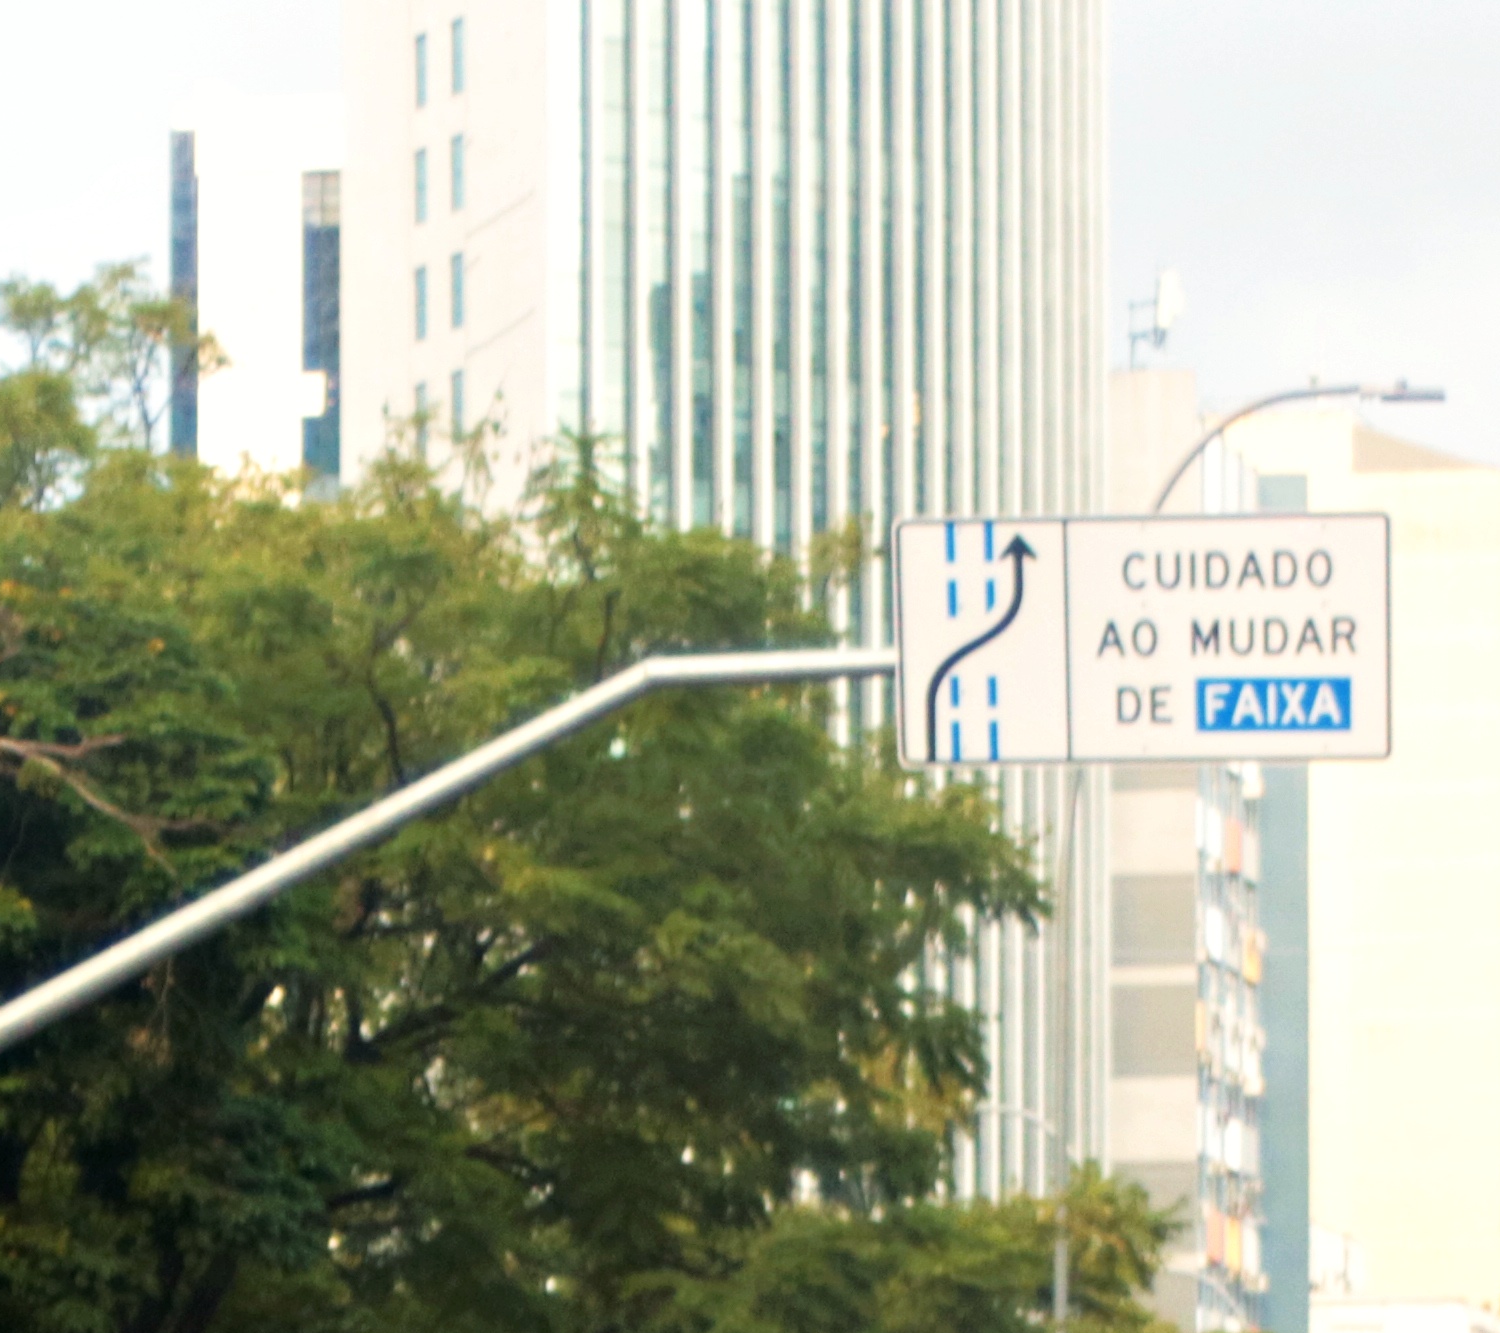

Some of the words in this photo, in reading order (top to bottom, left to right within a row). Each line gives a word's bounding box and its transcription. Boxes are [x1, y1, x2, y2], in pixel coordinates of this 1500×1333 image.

[1121, 549, 1335, 592] CUIDADO
[1097, 617, 1160, 658] AO
[1190, 616, 1360, 657] MUDAR
[1116, 684, 1174, 725] DE
[1203, 682, 1343, 728] FAIXA
